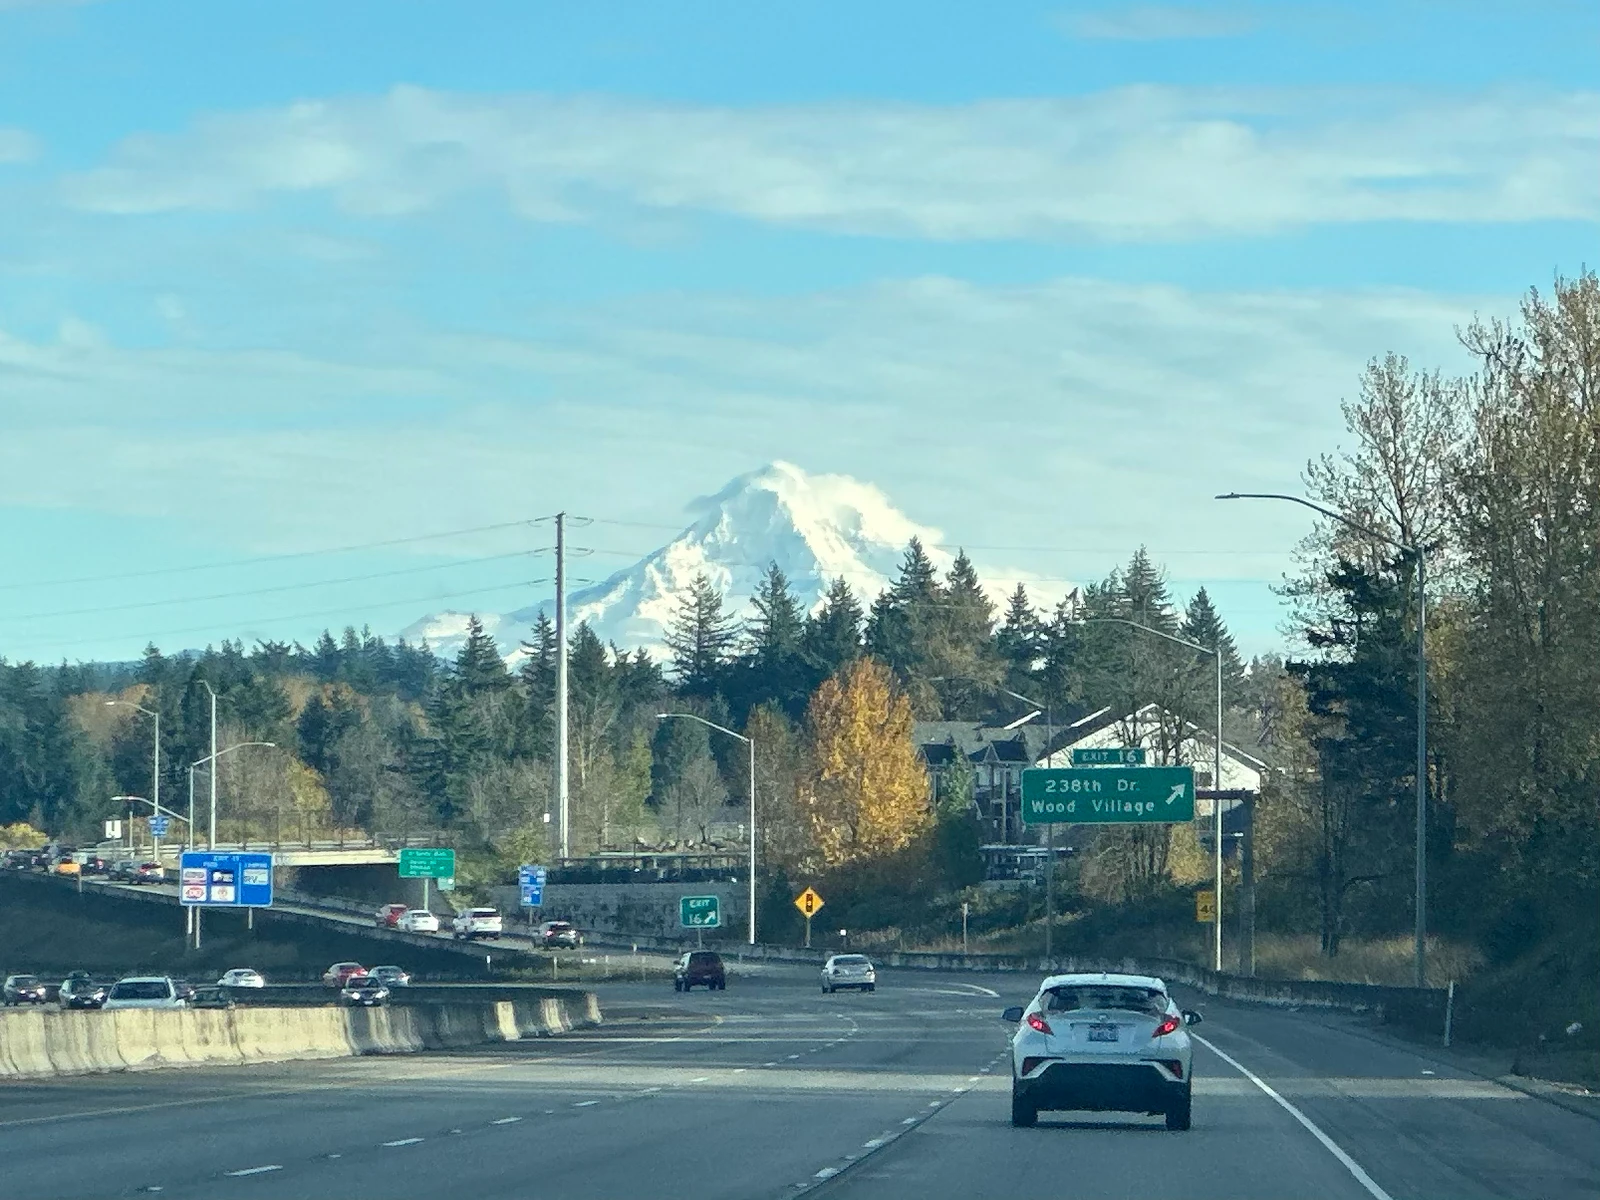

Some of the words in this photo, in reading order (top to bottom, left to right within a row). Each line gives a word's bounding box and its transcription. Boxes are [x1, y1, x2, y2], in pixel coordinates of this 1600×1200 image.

[1082, 751, 1108, 761] EXIT
[1119, 750, 1137, 762] 16
[1045, 779, 1101, 793] 238th
[1117, 779, 1140, 792] Dr.
[1031, 800, 1076, 813] Wood
[1092, 800, 1155, 816] Village
[689, 899, 710, 908] EXIT
[689, 913, 702, 924] 16
